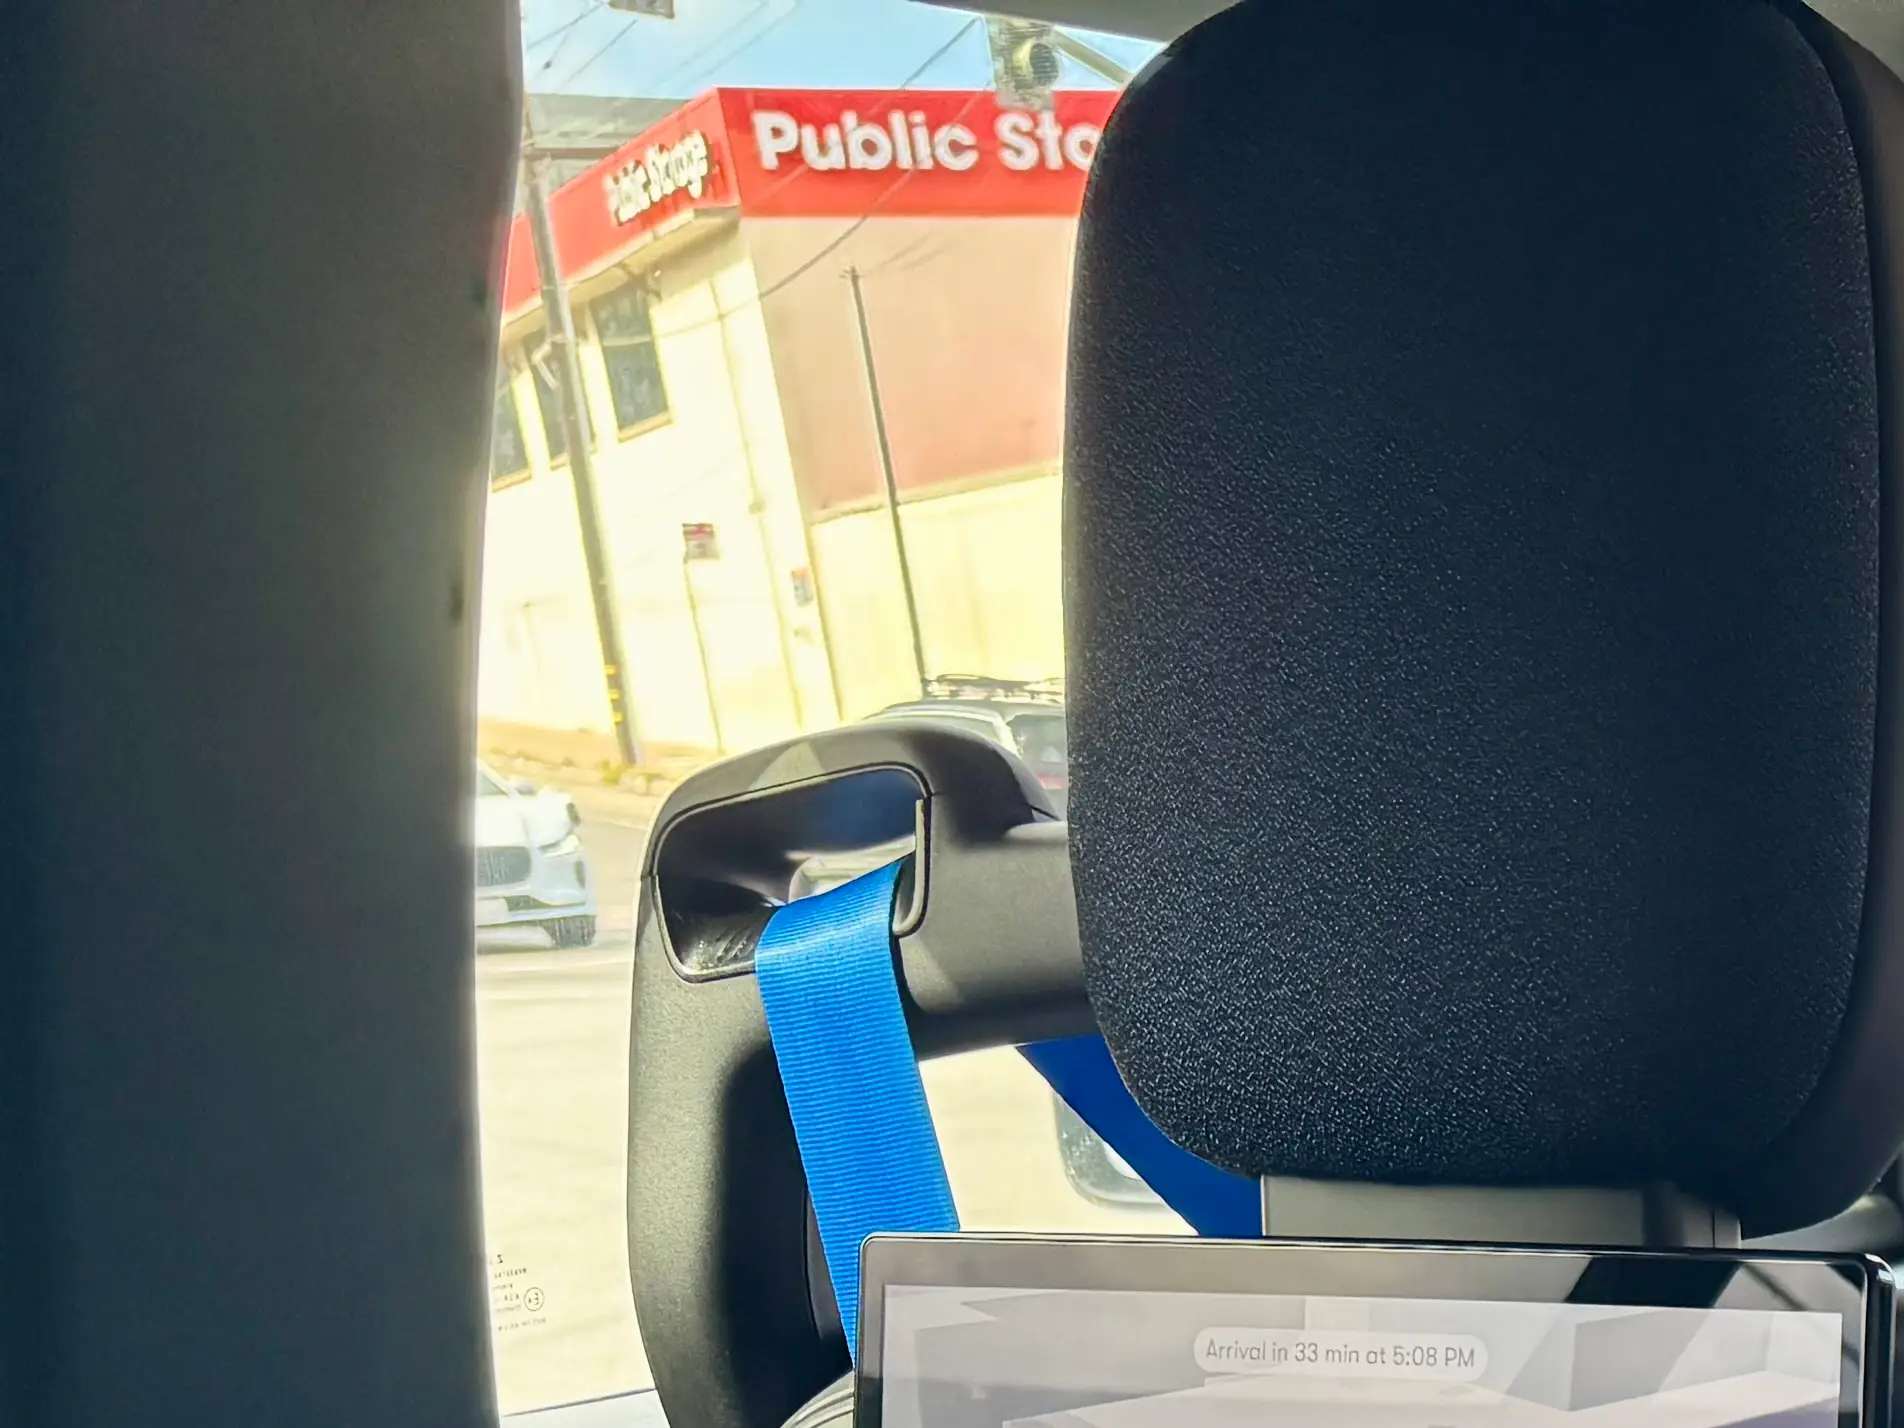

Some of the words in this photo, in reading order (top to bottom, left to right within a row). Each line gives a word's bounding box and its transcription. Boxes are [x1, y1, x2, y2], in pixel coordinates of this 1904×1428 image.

[752, 109, 979, 172] Public
[995, 111, 1099, 172] Sto
[1205, 1338, 1267, 1361] Arrival
[1271, 1341, 1288, 1362] in
[1294, 1342, 1319, 1363] 33
[1325, 1343, 1360, 1364] min
[1365, 1347, 1386, 1365] at
[1392, 1345, 1438, 1367] 5:08
[1444, 1346, 1475, 1368] PM
